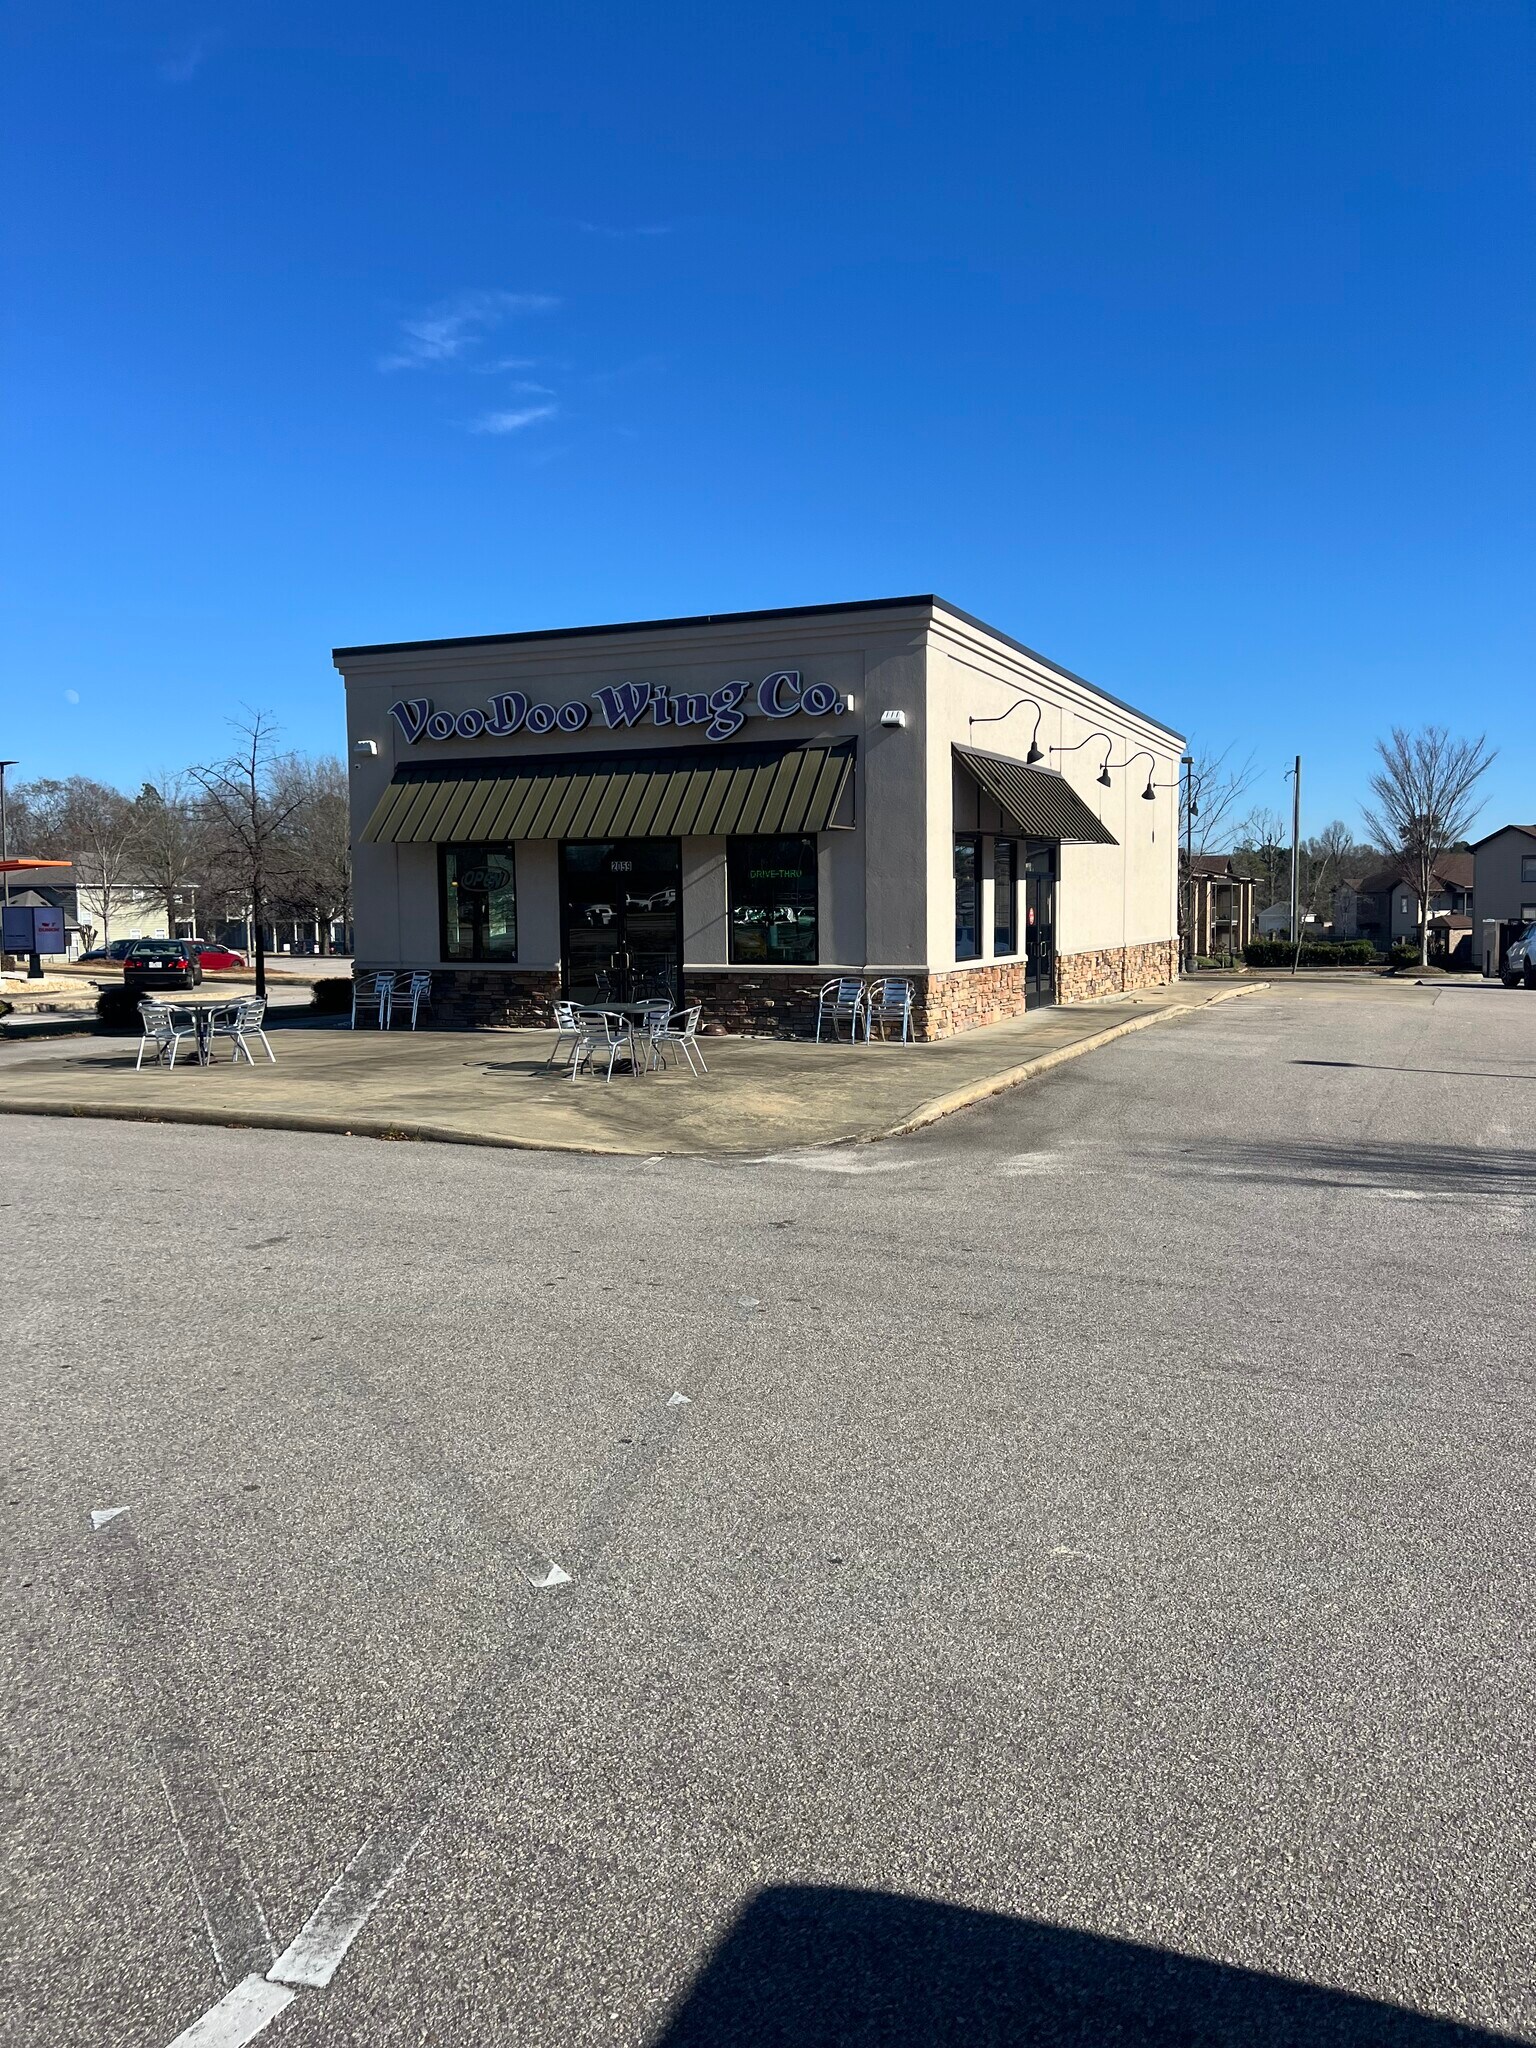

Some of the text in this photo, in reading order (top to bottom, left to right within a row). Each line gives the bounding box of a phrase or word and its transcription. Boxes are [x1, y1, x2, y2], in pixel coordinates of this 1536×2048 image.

[388, 670, 845, 745] VooDoo Wing Co.
[611, 861, 632, 872] 2059
[750, 869, 802, 878] DRIVE-THRU
[464, 869, 507, 889] OPEN
